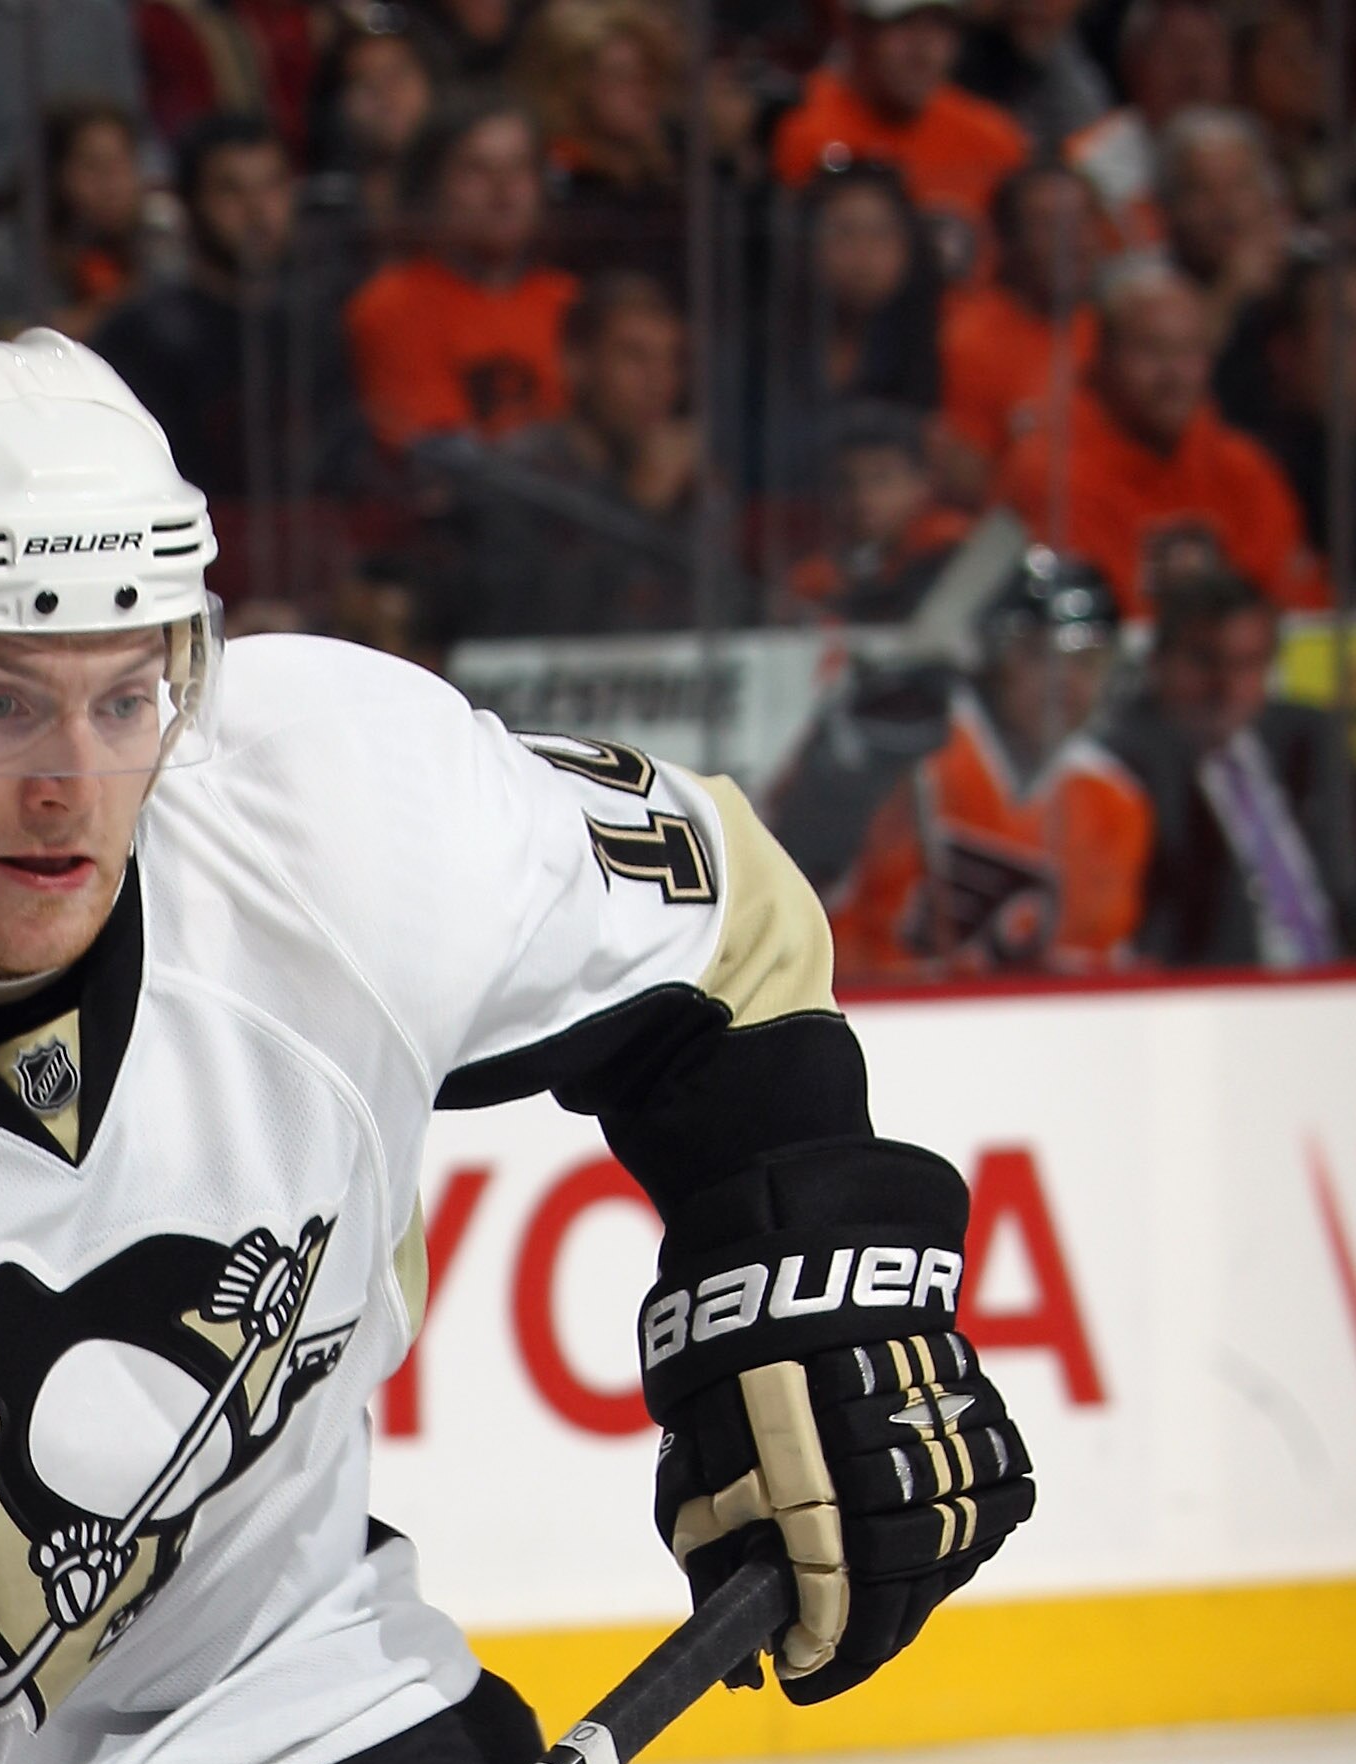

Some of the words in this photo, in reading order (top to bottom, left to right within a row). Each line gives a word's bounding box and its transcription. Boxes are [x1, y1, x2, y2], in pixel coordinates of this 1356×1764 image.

[23, 532, 143, 555] BAUER
[37, 1055, 63, 1101] NHL
[645, 1246, 963, 1371] BAUER
